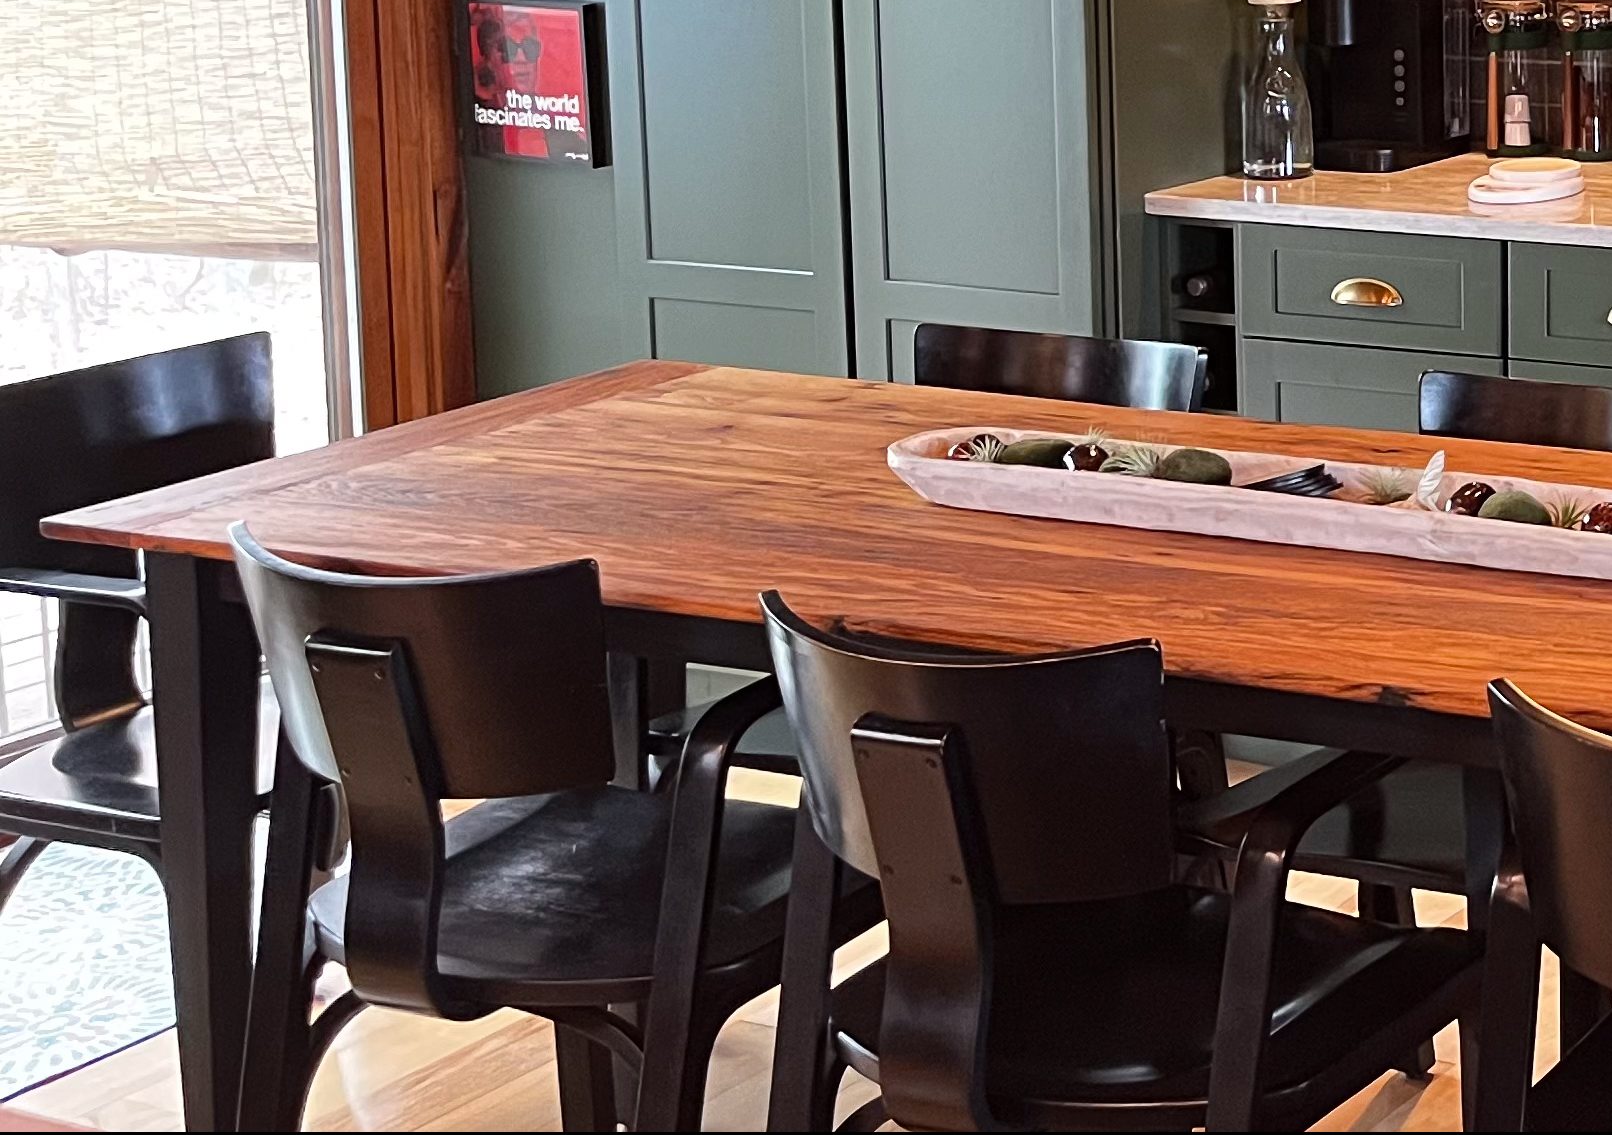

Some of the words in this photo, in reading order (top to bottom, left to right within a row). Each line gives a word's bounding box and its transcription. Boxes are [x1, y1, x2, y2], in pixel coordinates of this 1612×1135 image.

[506, 89, 532, 110] the
[535, 94, 580, 114] world
[474, 103, 551, 130] fascinates
[554, 115, 585, 132] me.
